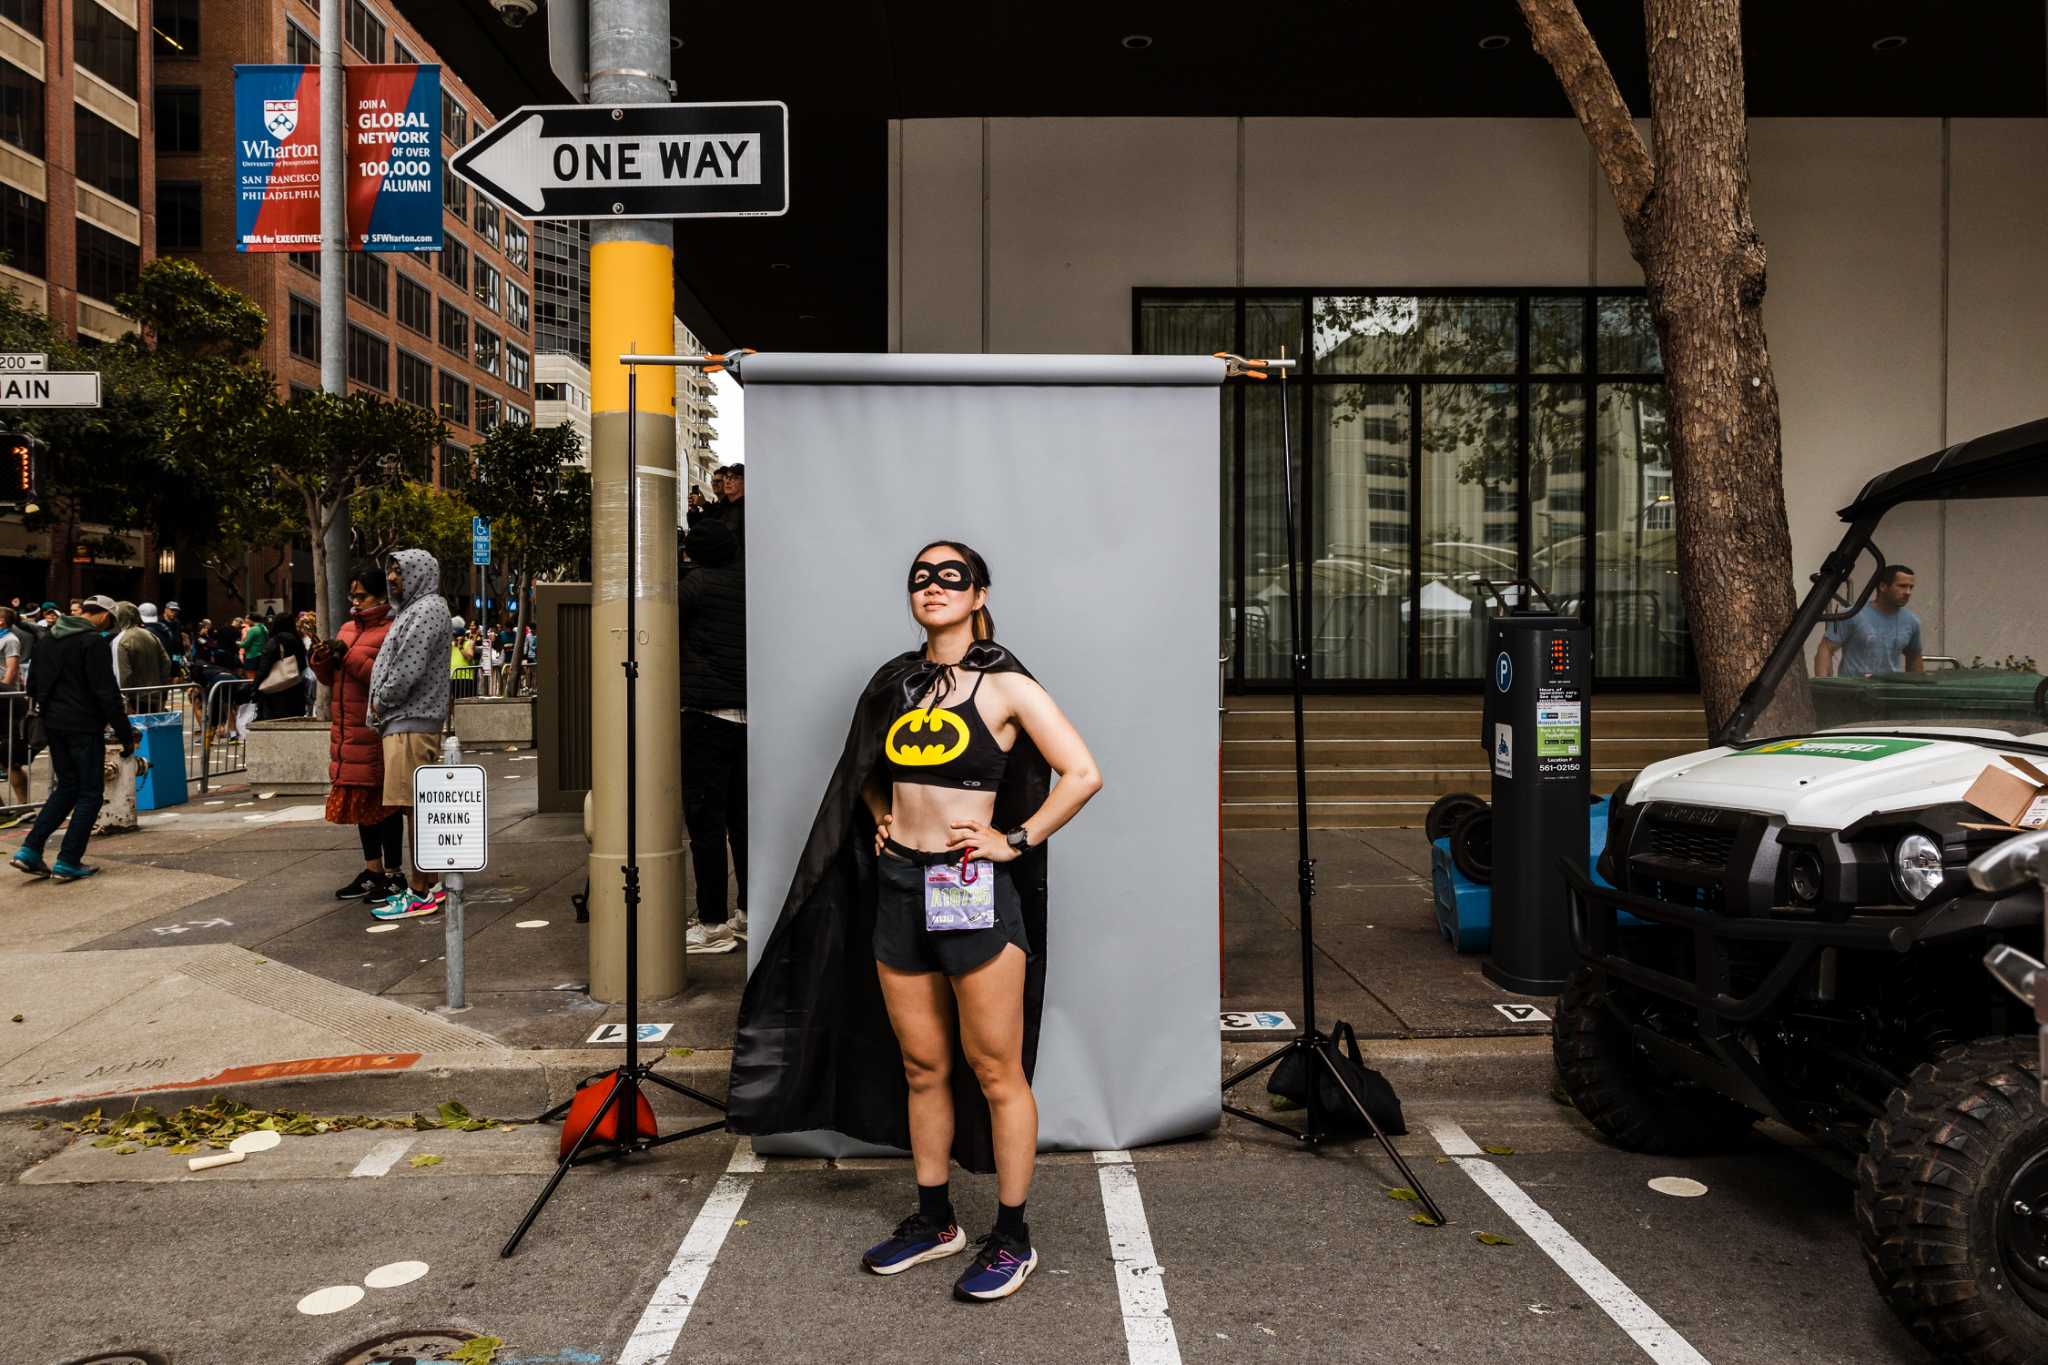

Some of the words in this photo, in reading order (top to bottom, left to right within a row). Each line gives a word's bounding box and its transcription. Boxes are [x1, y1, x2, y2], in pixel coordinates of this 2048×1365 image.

[359, 100, 378, 109] JOIN
[380, 99, 386, 108] A
[358, 112, 430, 128] GLOBAL
[358, 132, 430, 144] NETWORK
[242, 140, 319, 158] Wharton
[392, 147, 403, 157] OF
[406, 147, 430, 157] OVER
[553, 143, 642, 182] ONE
[659, 140, 750, 178] WAY
[360, 161, 430, 178] 100,000
[242, 176, 262, 184] SAN
[265, 174, 320, 184] FRANCISCO
[382, 180, 431, 192] ALUMNI
[242, 190, 320, 200] PHILADELPHIA
[243, 235, 262, 243] MBA
[263, 235, 274, 243] for
[372, 233, 432, 243] SFWharton.com
[0, 380, 49, 399] AIN
[419, 791, 481, 803] MOTORCYCLE
[428, 812, 470, 824] PARKING
[438, 834, 463, 846] ONLY
